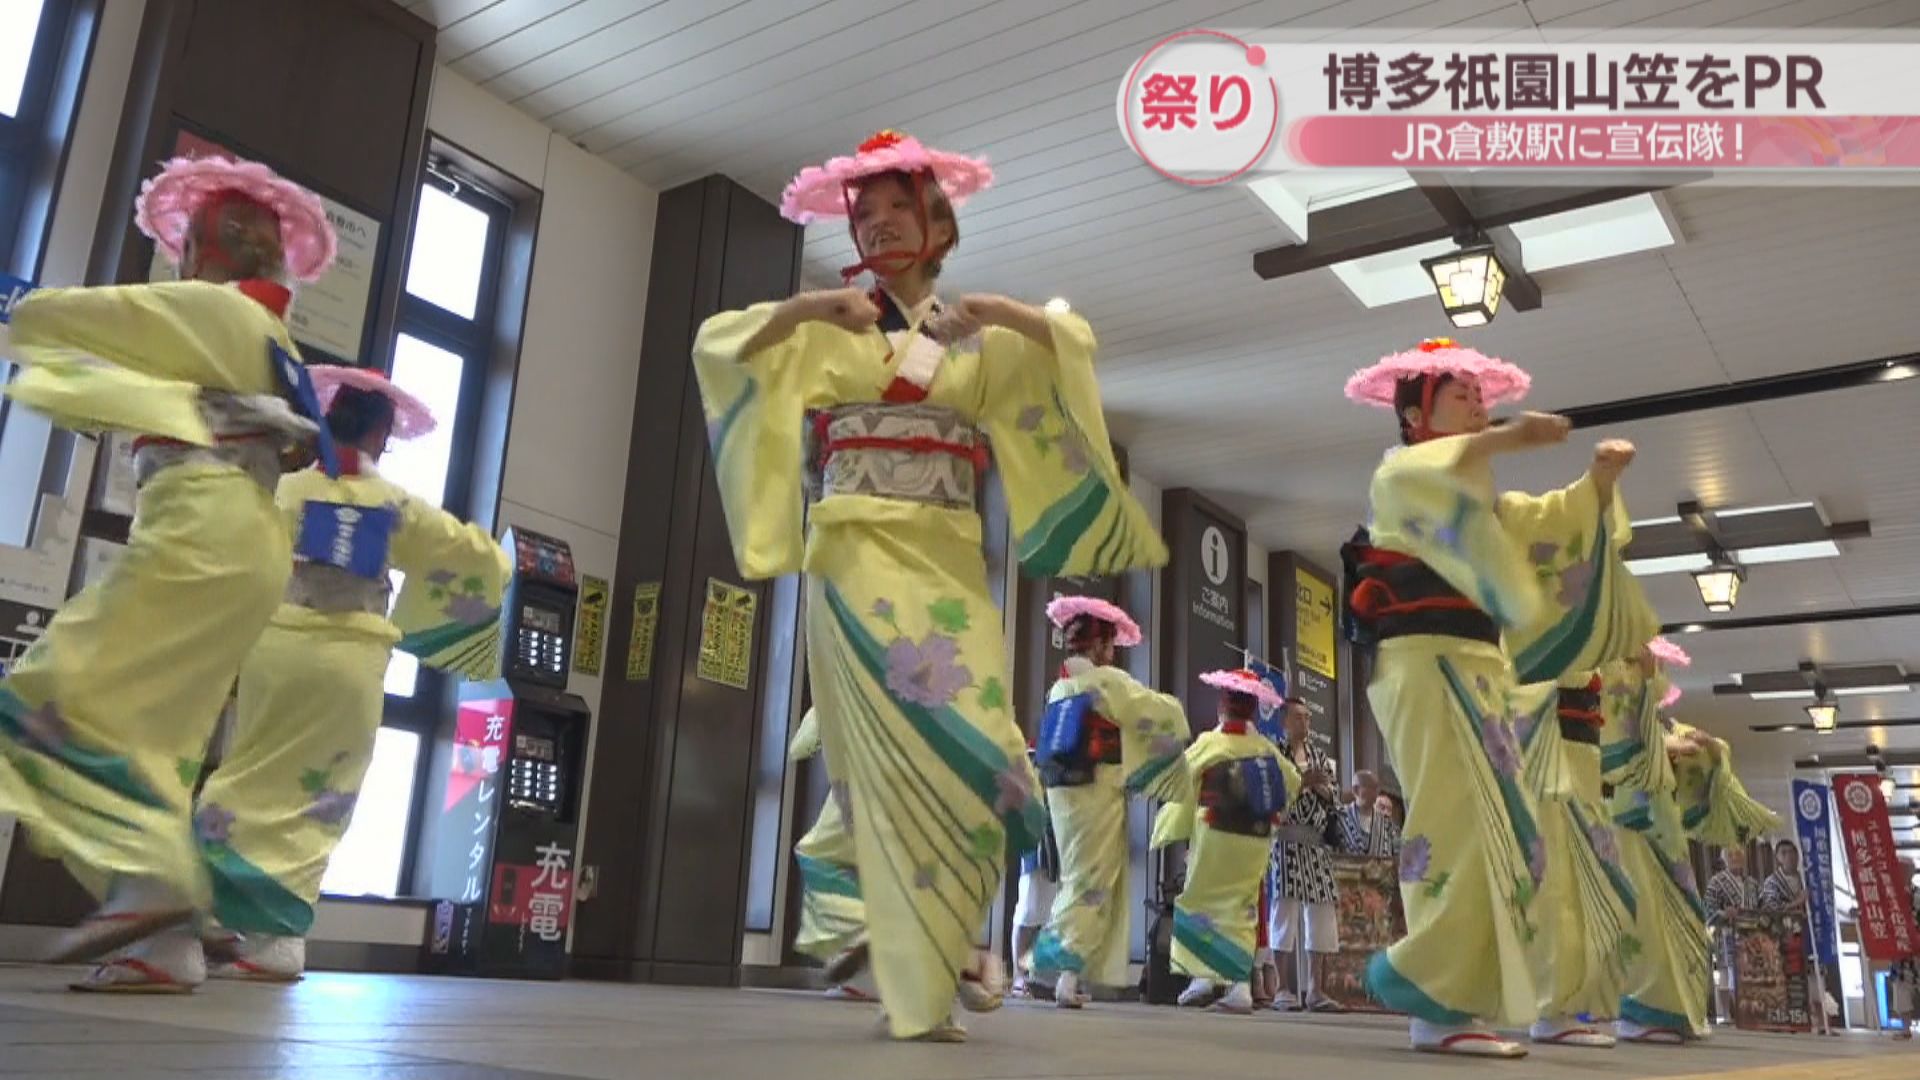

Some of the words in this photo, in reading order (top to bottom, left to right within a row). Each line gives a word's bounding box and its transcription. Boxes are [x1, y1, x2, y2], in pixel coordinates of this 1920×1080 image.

[462, 715, 506, 900] 充電レンタル
[528, 842, 572, 942] 充電
